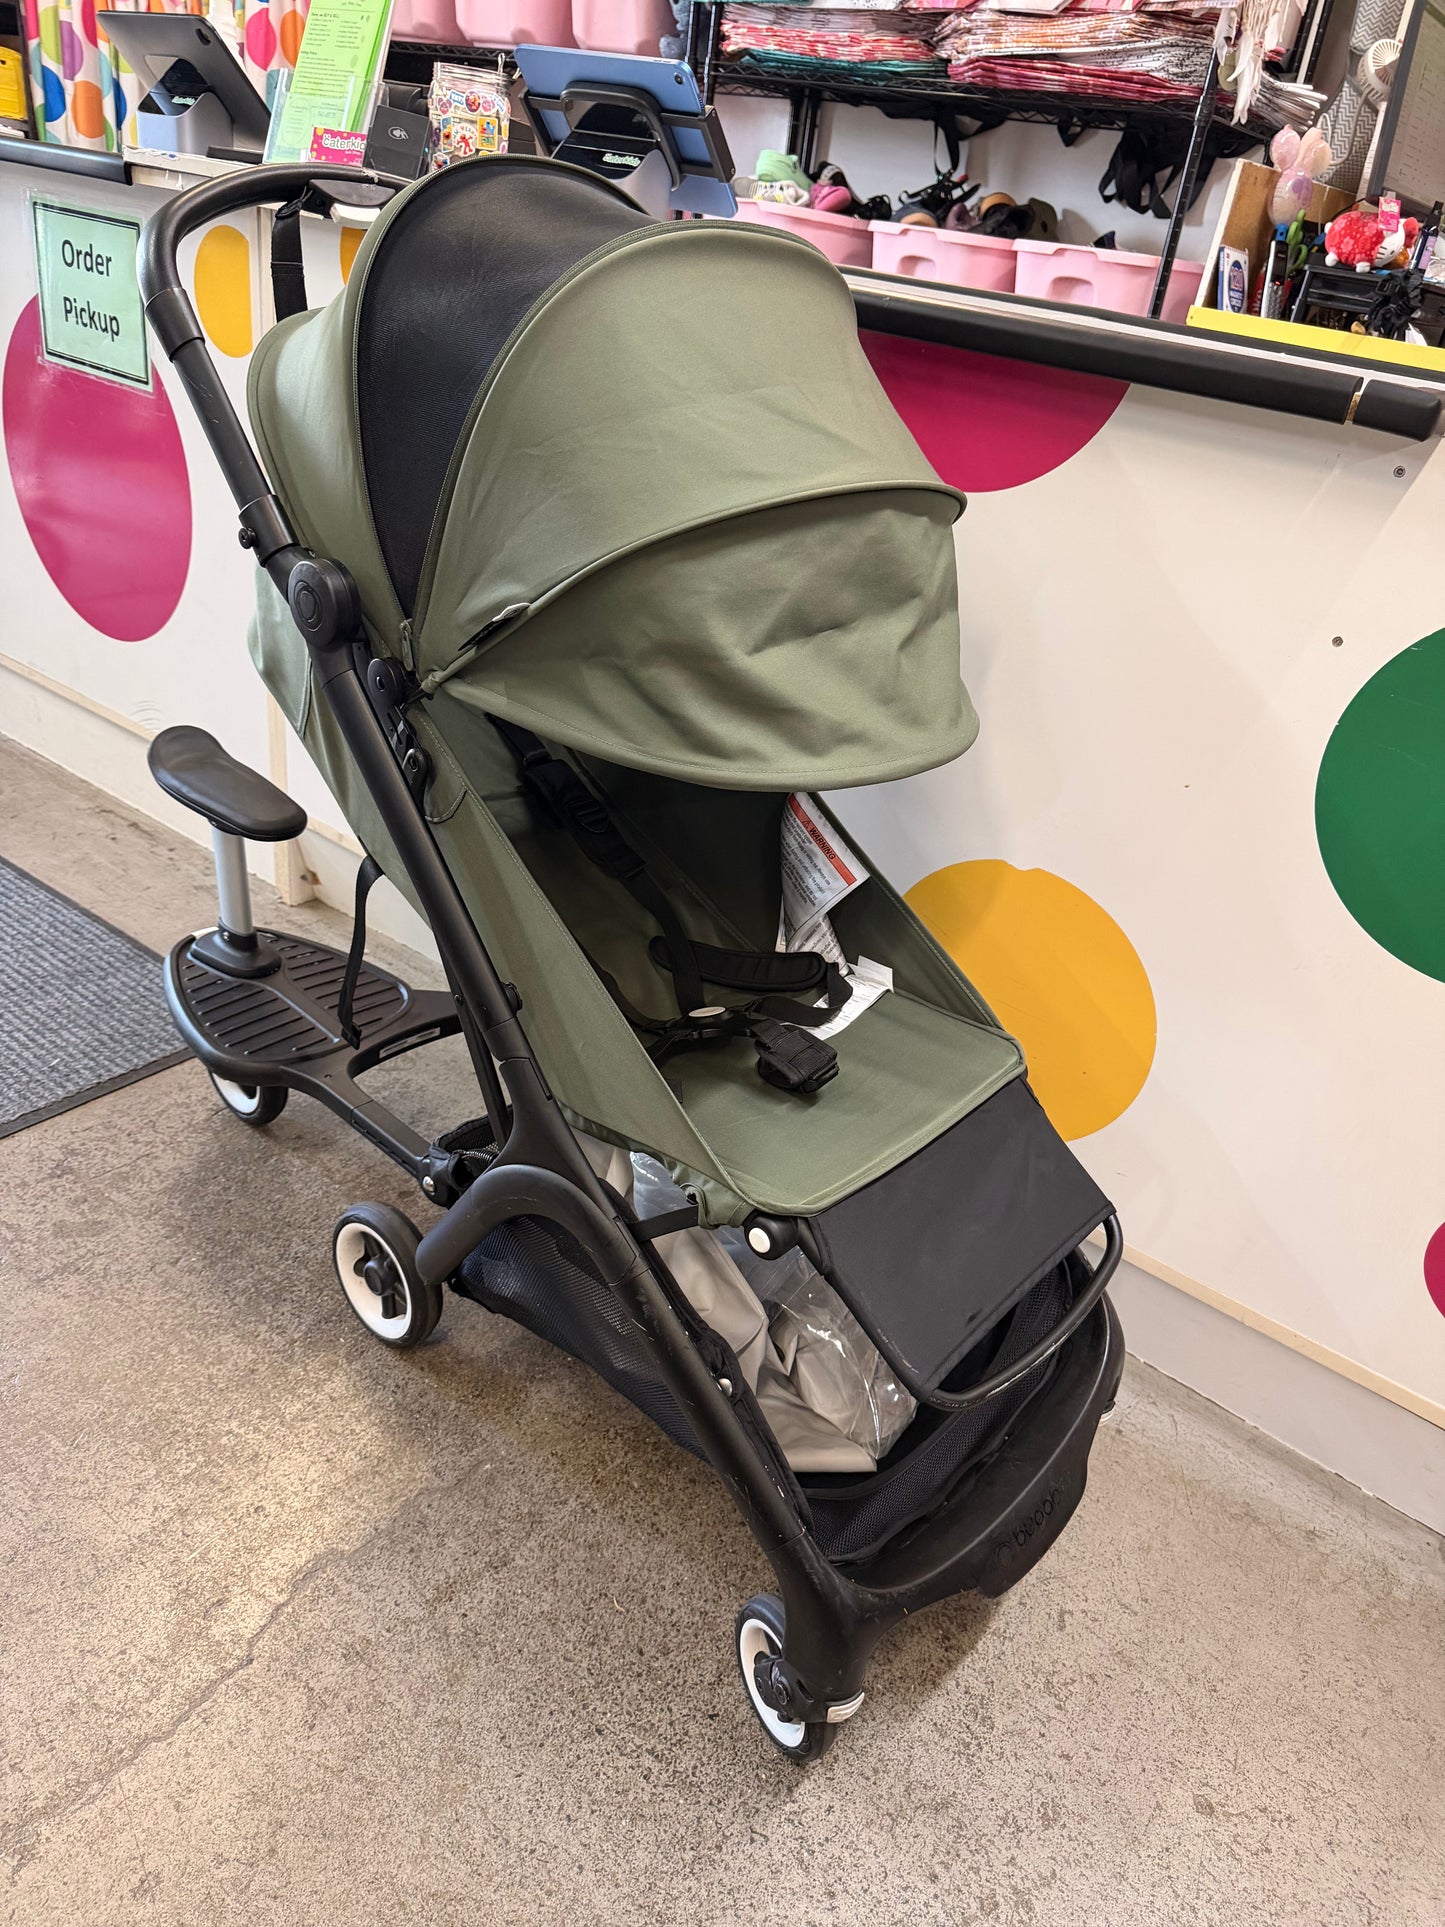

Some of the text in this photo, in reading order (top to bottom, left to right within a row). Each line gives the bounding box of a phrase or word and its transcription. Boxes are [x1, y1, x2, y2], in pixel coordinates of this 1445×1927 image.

[61, 239, 112, 277] Order
[62, 296, 121, 342] Pickup
[809, 827, 836, 860] WARNING
